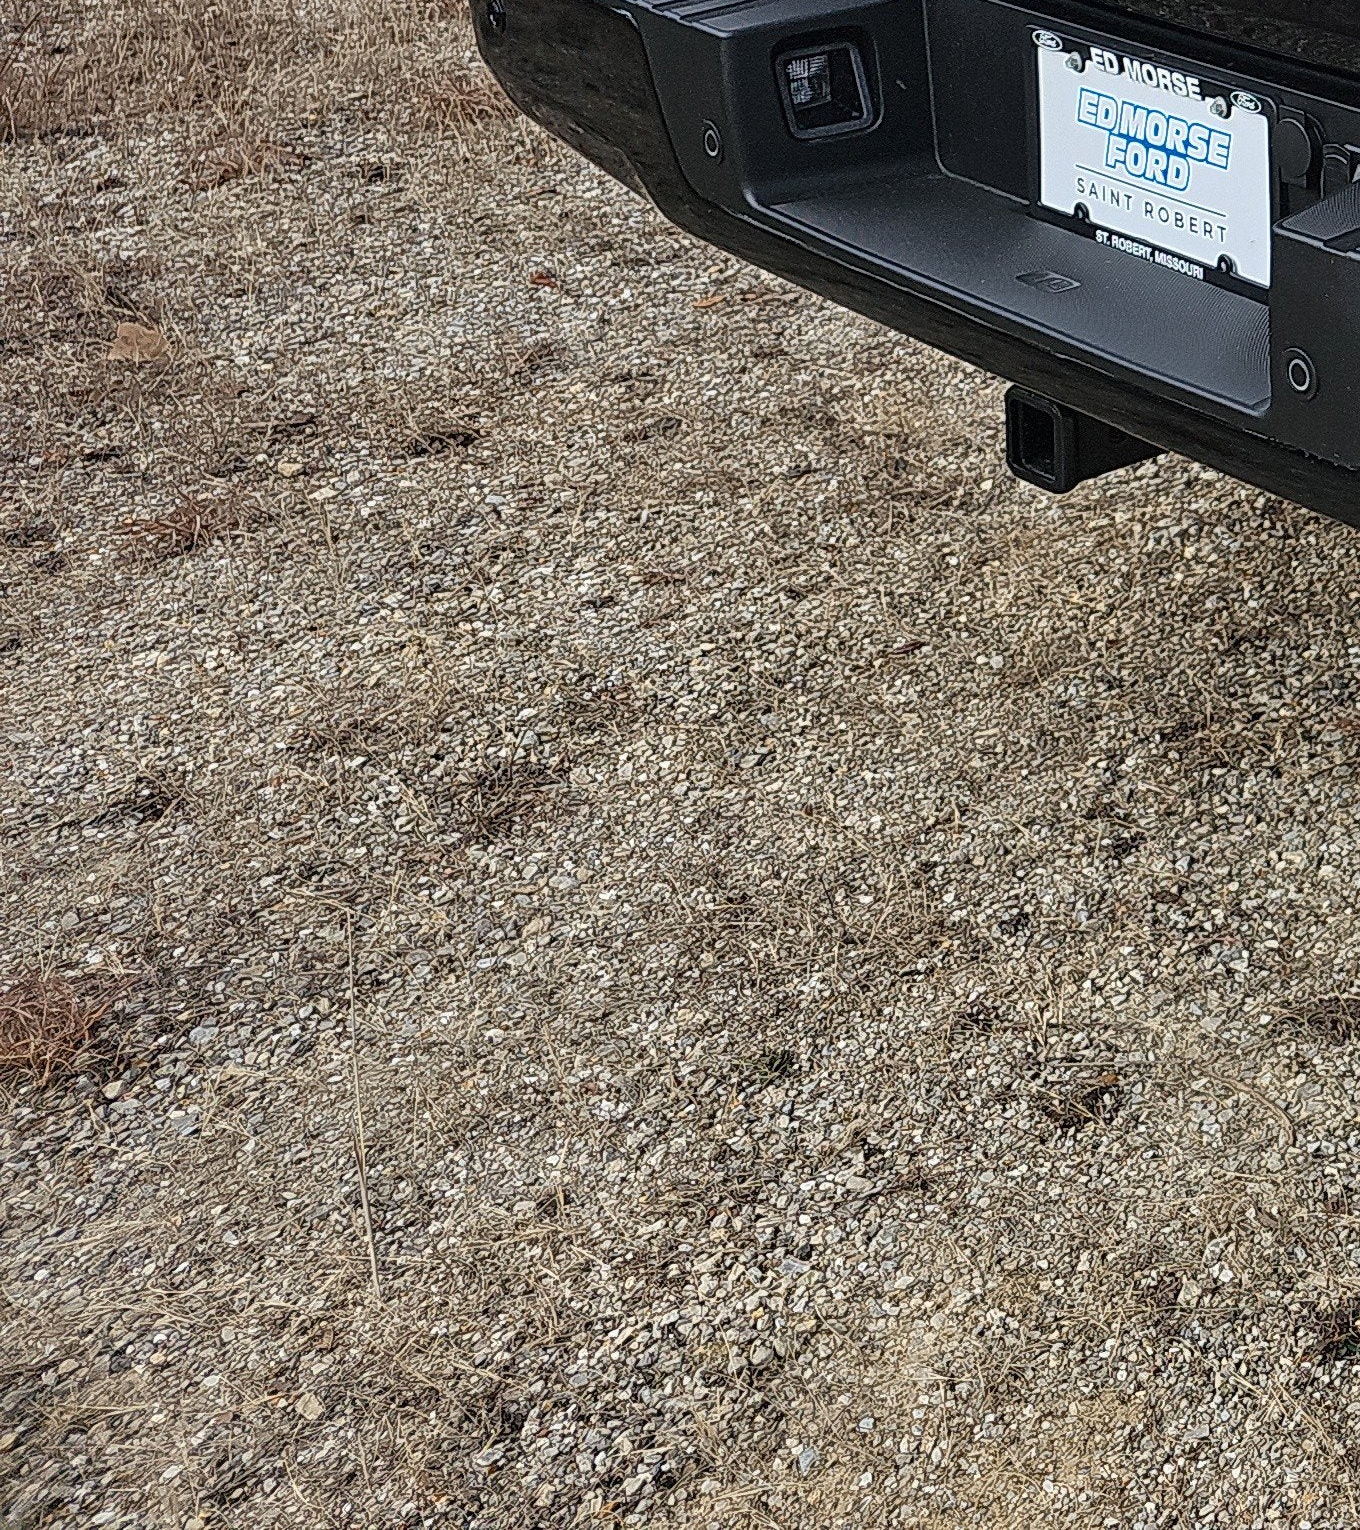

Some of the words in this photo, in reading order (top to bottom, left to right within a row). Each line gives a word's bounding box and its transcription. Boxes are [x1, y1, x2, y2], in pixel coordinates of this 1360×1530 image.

[1090, 46, 1119, 75] ED
[1123, 57, 1203, 101] MORSE
[1078, 87, 1118, 131] ED
[1118, 100, 1231, 170] MORSE
[1105, 132, 1190, 191] FORD
[1076, 177, 1133, 211] SAINT
[1144, 201, 1227, 243] ROBERT
[1094, 229, 1111, 246] ST.
[1111, 234, 1154, 263] ROBERT,
[1154, 250, 1204, 280] MISSOURI
